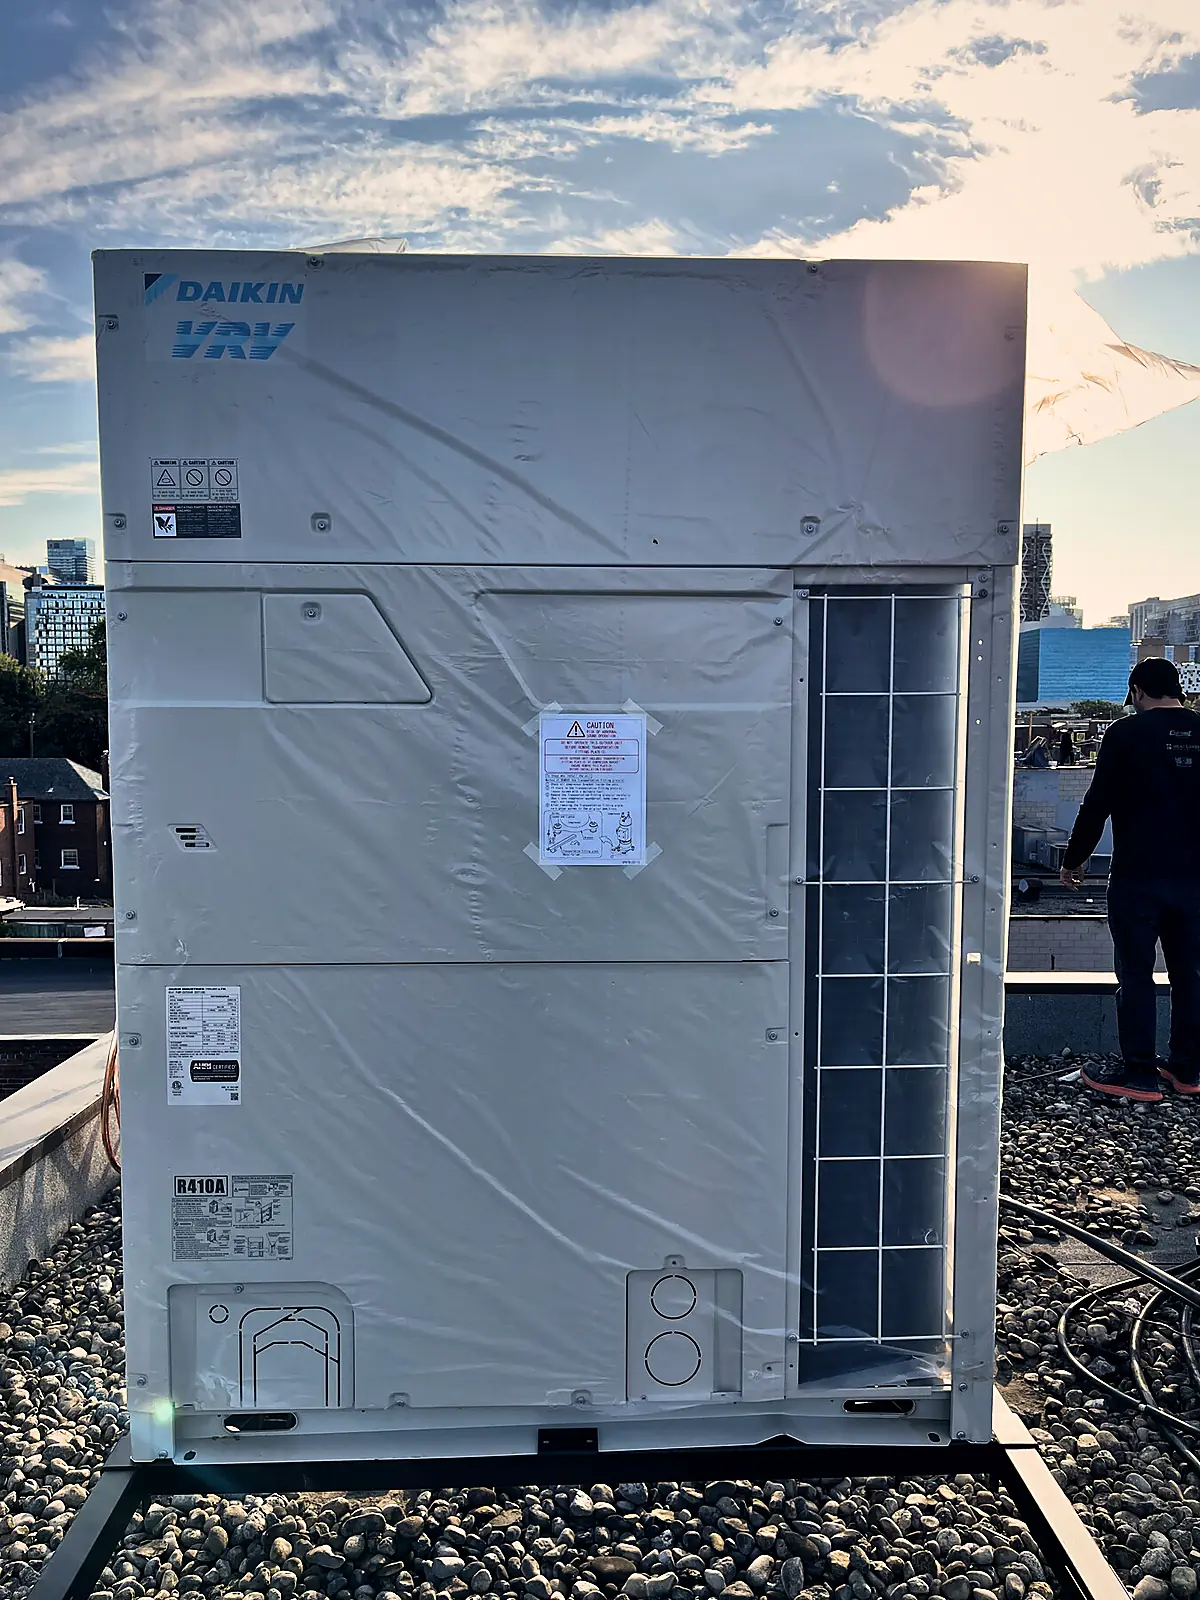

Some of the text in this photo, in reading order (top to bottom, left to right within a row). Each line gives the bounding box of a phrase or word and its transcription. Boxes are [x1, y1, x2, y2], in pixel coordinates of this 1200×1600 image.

[176, 281, 304, 304] DAIKIN
[171, 320, 295, 360] VRV
[586, 721, 614, 729] CAUTION
[177, 1179, 225, 1194] R410A
